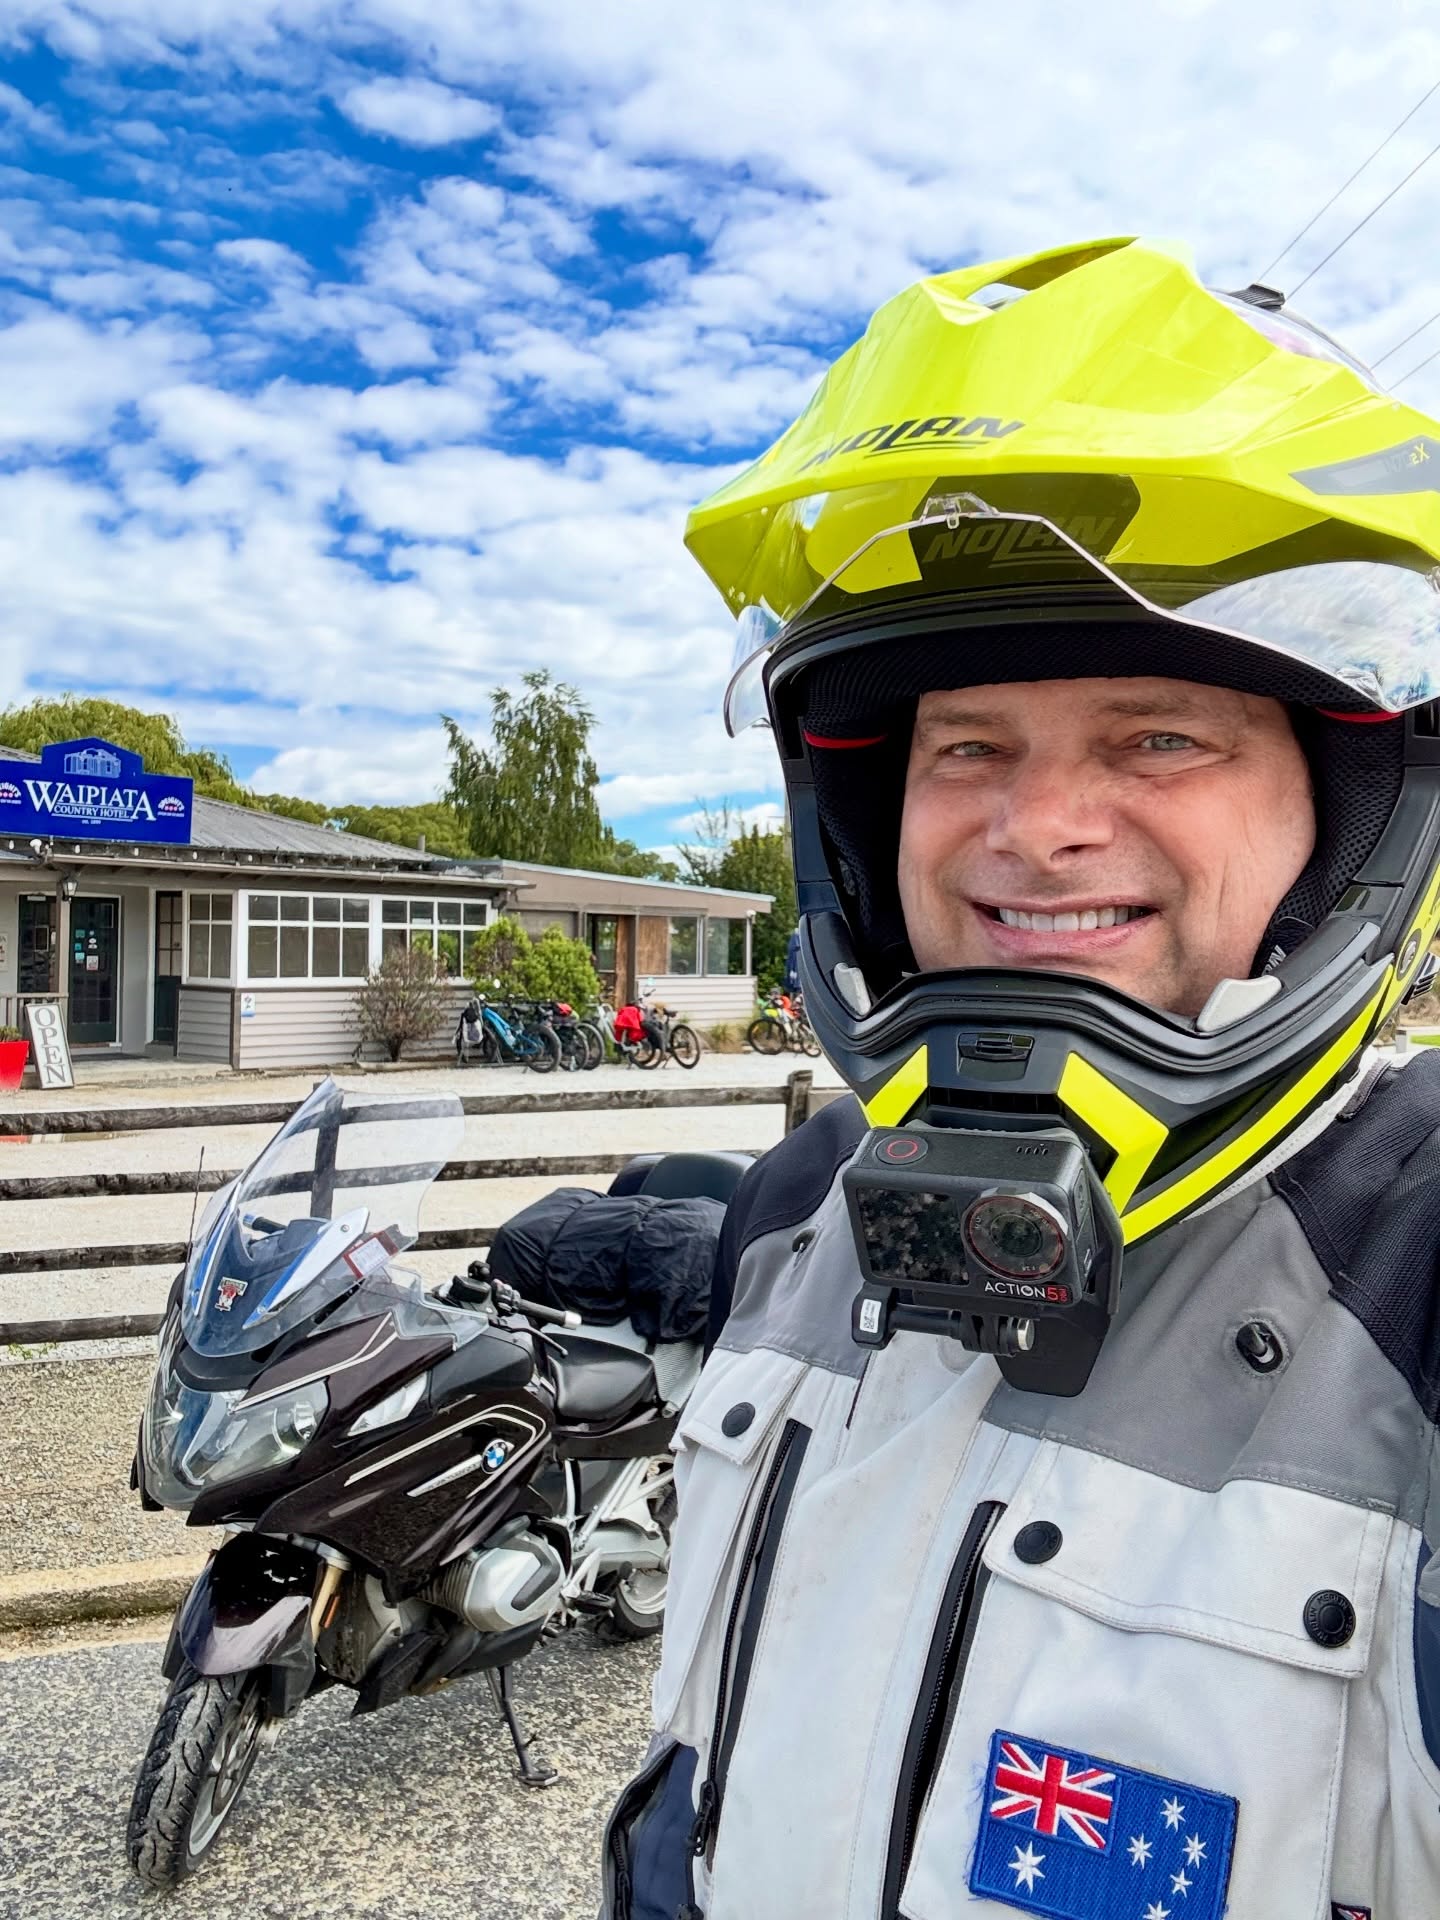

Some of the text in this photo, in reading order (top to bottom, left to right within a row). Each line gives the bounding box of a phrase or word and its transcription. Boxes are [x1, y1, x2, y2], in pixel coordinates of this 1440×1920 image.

[796, 417, 1025, 473] NOLAN
[921, 515, 1115, 563] NOLAN
[23, 780, 156, 821] WAIPIATA
[53, 804, 130, 819] COUNTRY HOTEL
[35, 1008, 65, 1083] OPEN
